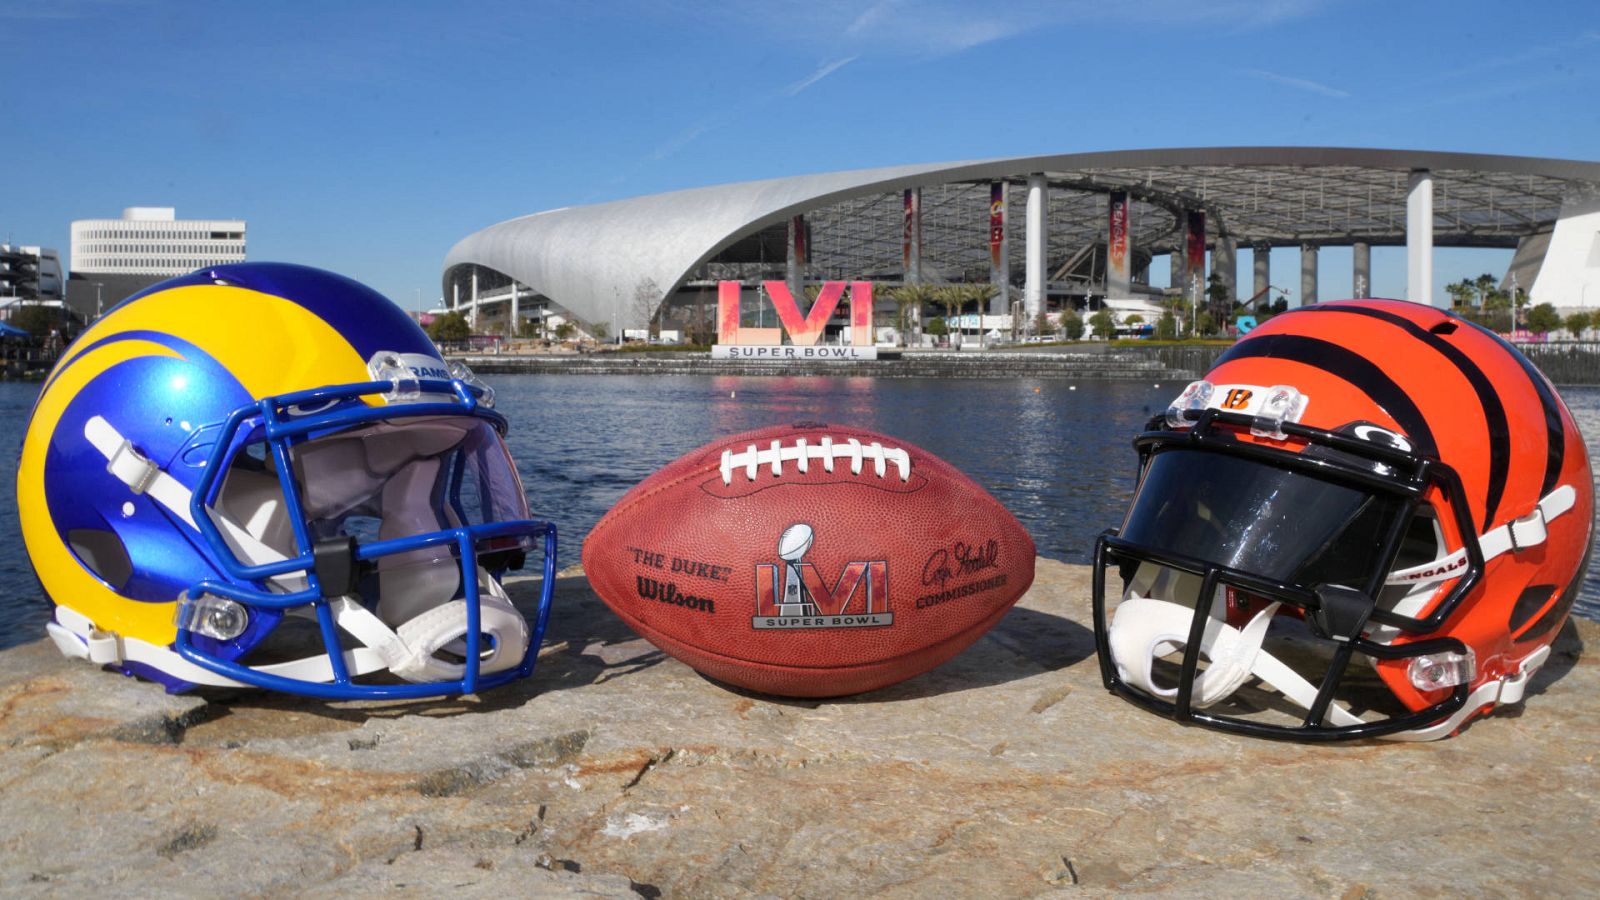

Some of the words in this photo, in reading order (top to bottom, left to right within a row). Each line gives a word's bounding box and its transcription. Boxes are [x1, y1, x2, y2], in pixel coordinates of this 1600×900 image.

[718, 280, 873, 346] LVI
[729, 347, 795, 357] SUPER
[804, 347, 860, 357] BOWL
[637, 575, 716, 613] Wilson
[755, 560, 888, 616] LVI
[915, 573, 1008, 609] COMMISSIONER
[766, 618, 825, 626] SUPER
[832, 616, 880, 625] BOWL
